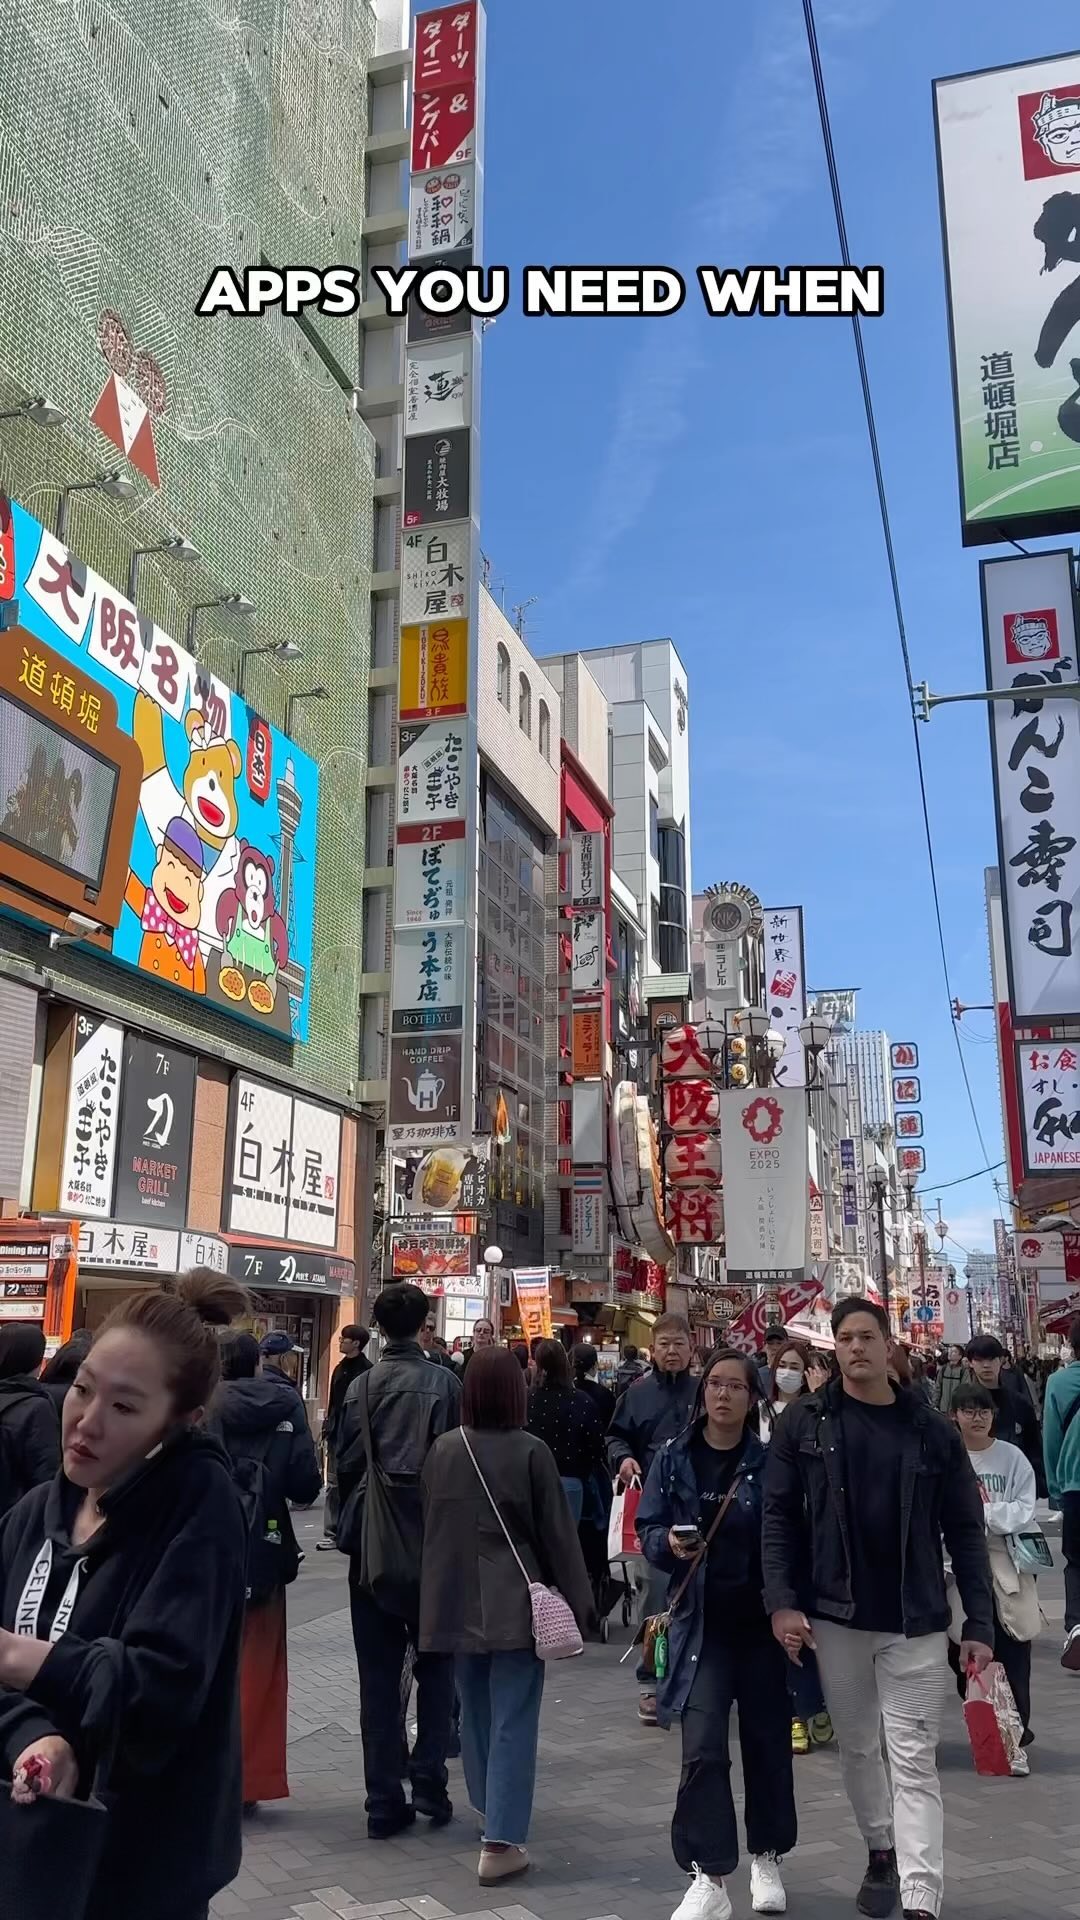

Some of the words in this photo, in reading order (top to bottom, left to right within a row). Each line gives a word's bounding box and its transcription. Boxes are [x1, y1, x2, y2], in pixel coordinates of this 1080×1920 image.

[450, 11, 471, 70] ダーツ
[419, 19, 443, 169] ダイニングバー
[449, 93, 469, 114] &
[456, 149, 472, 161] 9F
[980, 351, 1020, 471] 道頓堀店
[407, 514, 418, 525] 5F
[406, 535, 423, 548] 4F
[424, 536, 465, 616] 白木屋
[38, 552, 228, 736] 大阪名物
[18, 647, 102, 735] 道頓堀
[401, 731, 417, 742] 3F
[444, 732, 463, 809] たこやき
[425, 767, 446, 811] 王子
[422, 826, 442, 840] 2F
[703, 881, 751, 901] NIKOH
[715, 912, 736, 925] NK
[770, 915, 793, 963] 新世界
[78, 1015, 94, 1037] 3F
[402, 1012, 453, 1025] BOTEJYU
[402, 1047, 427, 1056] HAND
[430, 1046, 452, 1055] DRIP
[409, 1055, 445, 1064] COFFEE
[1029, 1048, 1078, 1072] お食
[155, 1052, 170, 1076] 7F
[240, 1091, 255, 1113] 4F
[419, 1090, 434, 1109] H
[94, 1047, 117, 1181] たこやき
[445, 1105, 457, 1117] 1F
[73, 1098, 97, 1176] 王子
[392, 1124, 458, 1141] 星乃珈琲店
[660, 1025, 722, 1242] 大阪王将
[239, 1121, 324, 1199] 白木屋
[749, 1151, 780, 1160] EXPO
[750, 1160, 780, 1169] 2025
[1033, 1151, 1080, 1164] JAPANESE
[132, 1156, 178, 1181] MARKET
[137, 1176, 170, 1198] GRILL
[463, 1174, 474, 1207] 専門店
[77, 1220, 148, 1259] 白木屋
[185, 1234, 194, 1244] 4F
[27, 1245, 42, 1256] Bar
[195, 1235, 225, 1270] 白木屋
[243, 1254, 263, 1277] 7F
[18, 1559, 51, 1636] CELINE
[51, 1597, 73, 1644] INE
